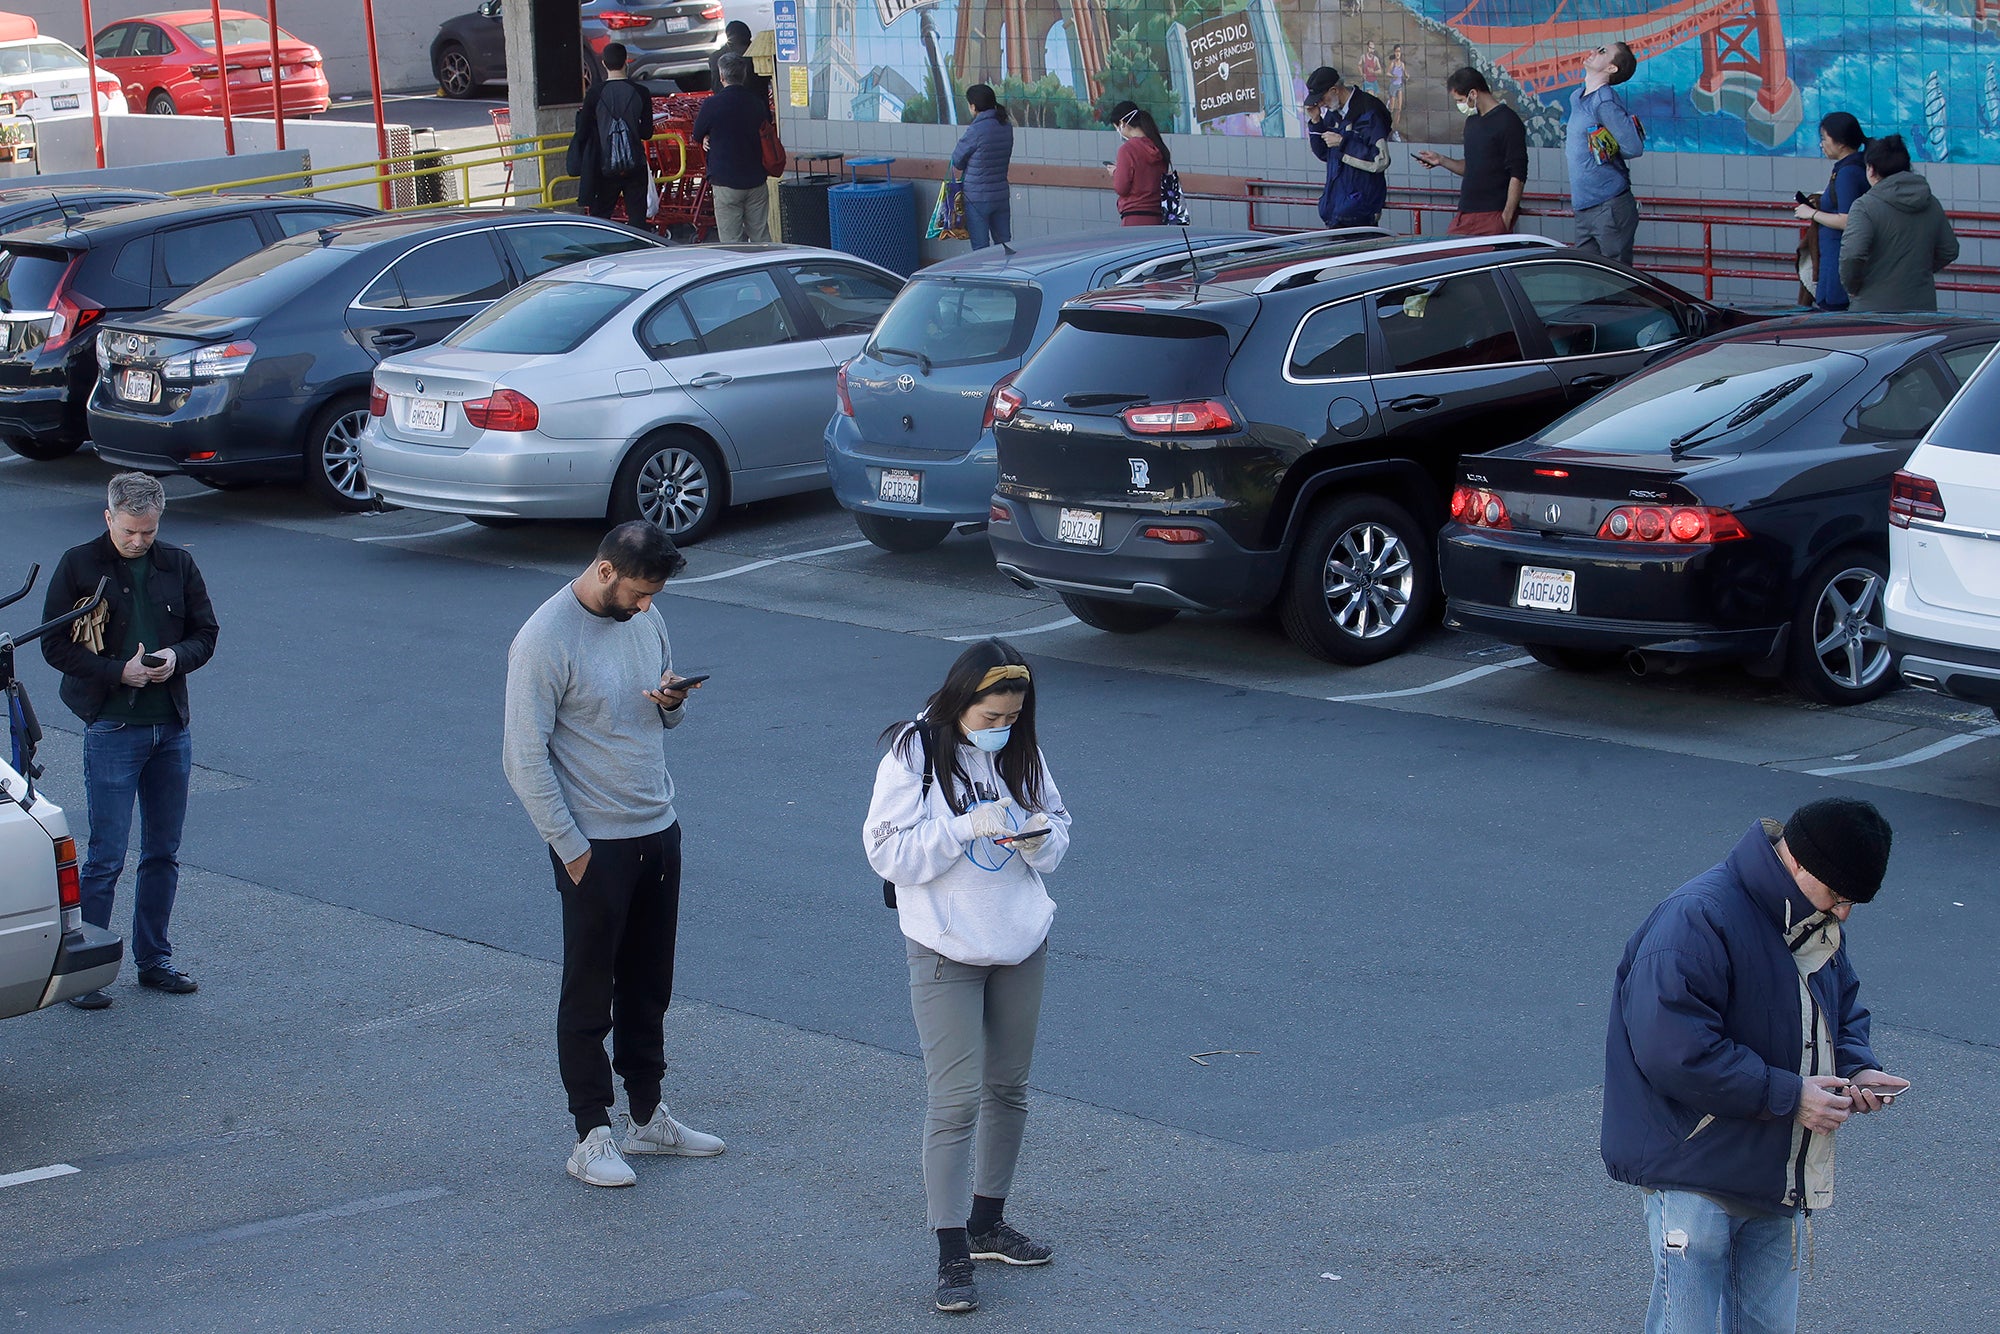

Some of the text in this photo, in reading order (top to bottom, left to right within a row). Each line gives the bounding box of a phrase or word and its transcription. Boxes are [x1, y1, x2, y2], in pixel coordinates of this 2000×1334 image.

[1190, 23, 1248, 56] PRESIDIO
[1193, 41, 1255, 70] OF SAN FRANCISCO
[1200, 87, 1256, 111] GOLDEN GATE
[961, 390, 984, 399] YARIS
[411, 409, 441, 427] 8MRZ861
[1050, 419, 1073, 435] Jeep
[1466, 473, 1489, 483] ACURA
[1060, 520, 1098, 540] 8DXZ491
